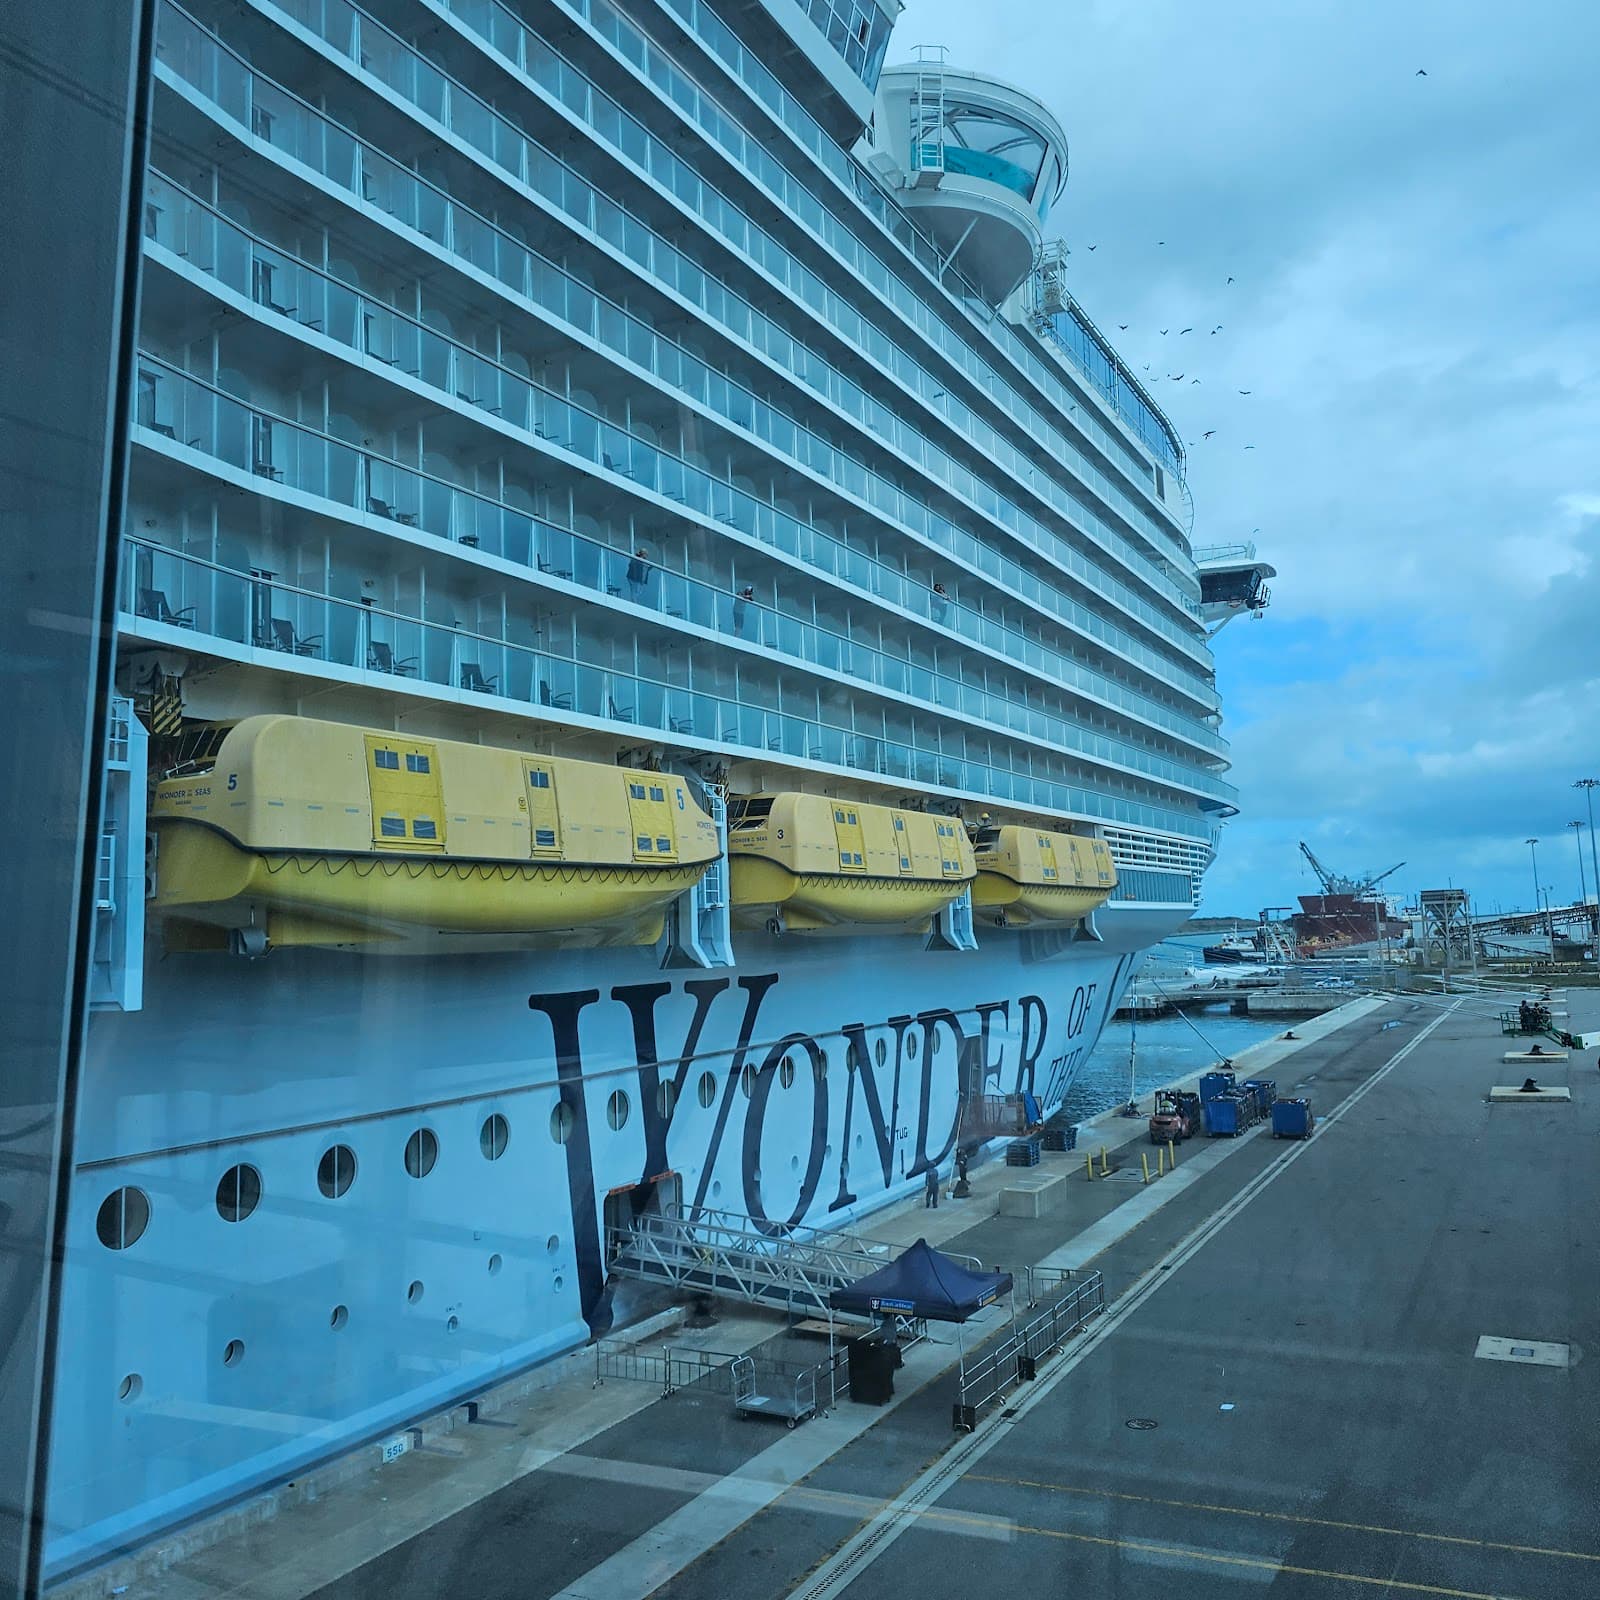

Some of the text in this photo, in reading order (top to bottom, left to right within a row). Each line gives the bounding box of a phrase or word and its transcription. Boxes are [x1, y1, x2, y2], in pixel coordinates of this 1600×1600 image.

[228, 774, 238, 790] 5
[194, 787, 211, 796] SEAS
[676, 789, 684, 810] 5
[777, 829, 784, 839] 3
[1067, 984, 1096, 1039] OF
[1042, 1047, 1083, 1112] THE
[895, 1127, 908, 1140] TUG
[528, 973, 1048, 1342] WONDER
